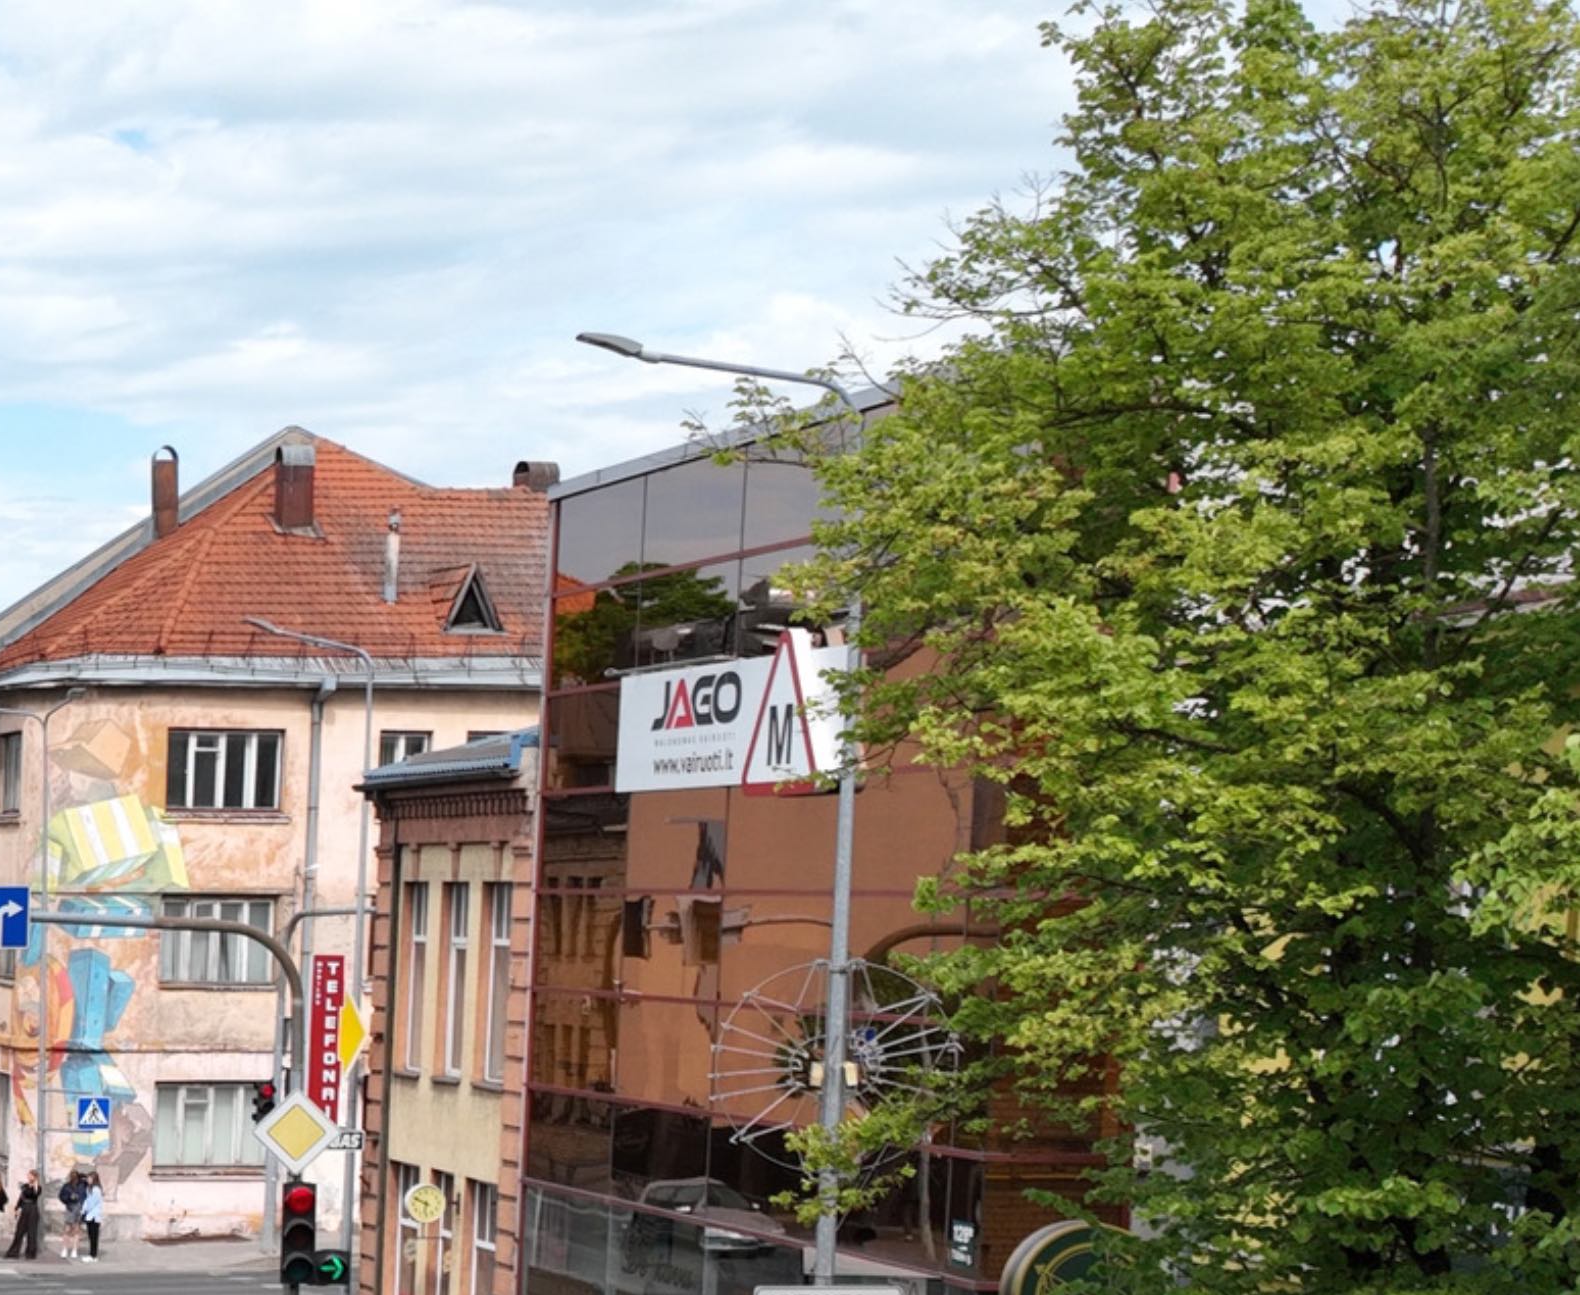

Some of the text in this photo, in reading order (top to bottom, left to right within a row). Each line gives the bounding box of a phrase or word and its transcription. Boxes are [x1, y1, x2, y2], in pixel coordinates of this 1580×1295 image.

[651, 671, 742, 731] JAGO
[653, 748, 733, 776] www.vairuoti.lt
[767, 704, 793, 766] M
